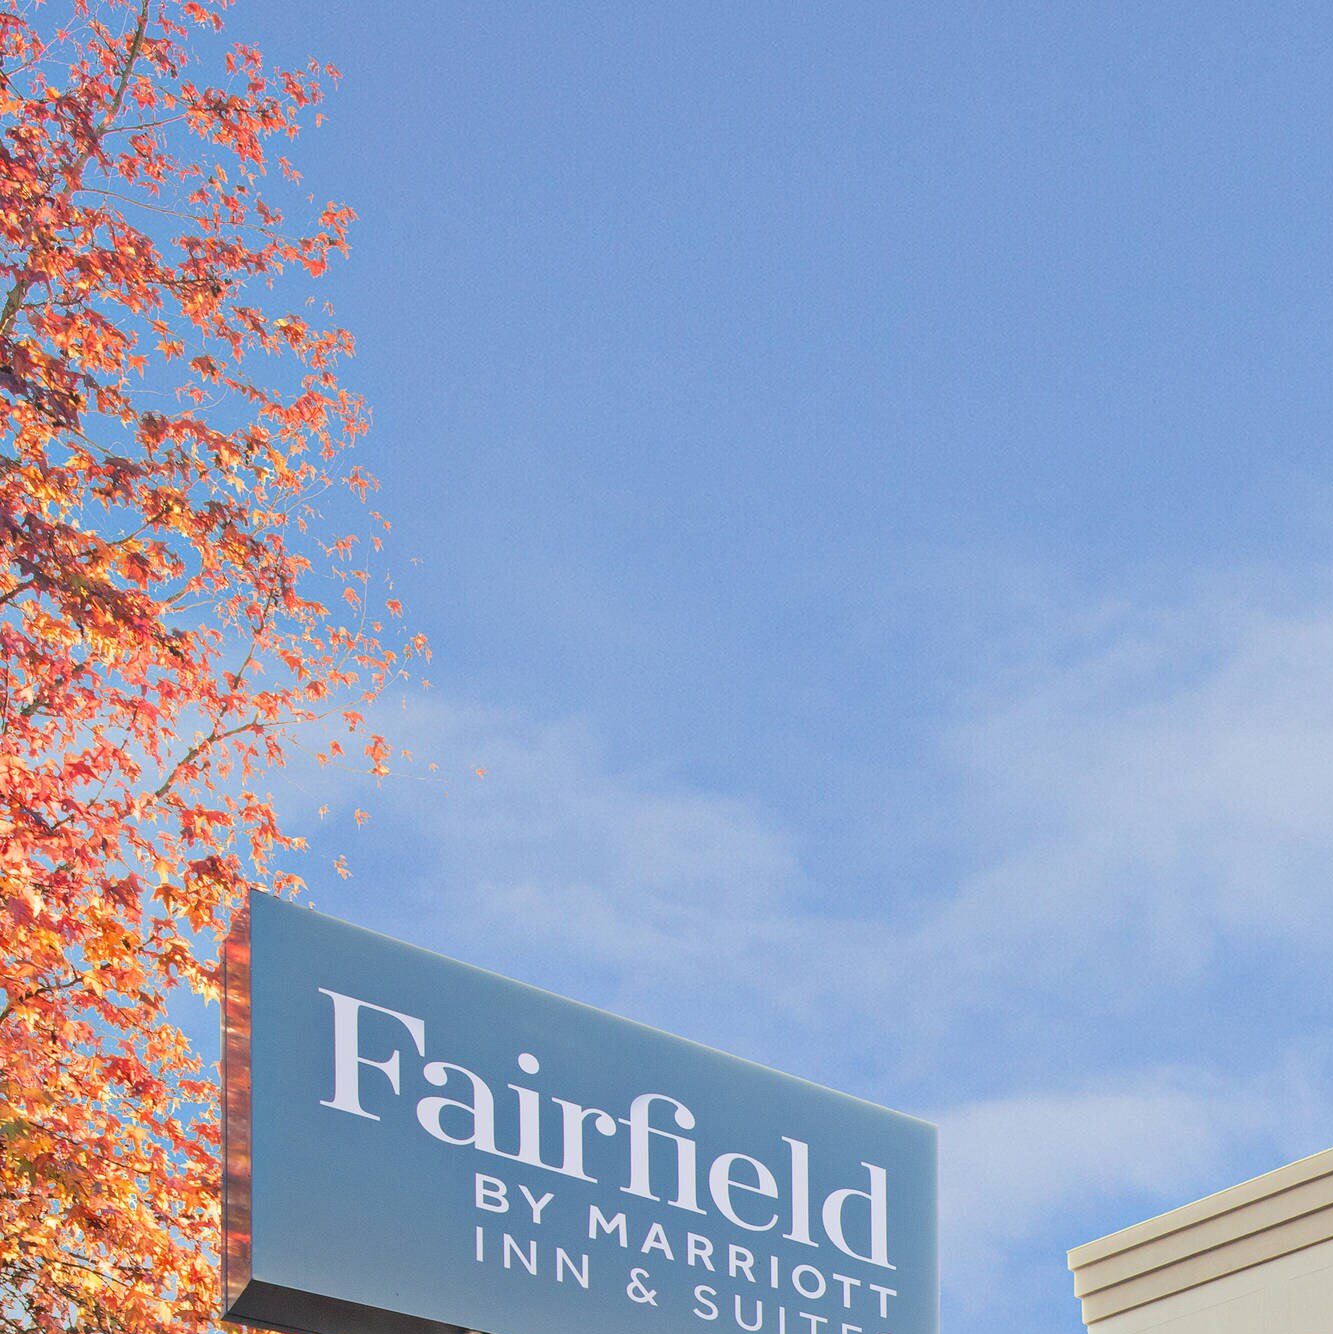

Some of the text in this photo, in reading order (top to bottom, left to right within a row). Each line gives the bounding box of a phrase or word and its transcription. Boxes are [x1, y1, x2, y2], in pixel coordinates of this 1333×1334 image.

[319, 987, 897, 1270] Fairfield
[475, 1172, 897, 1318] BY MARRIOTT
[476, 1226, 590, 1288] INN
[626, 1268, 658, 1305] &
